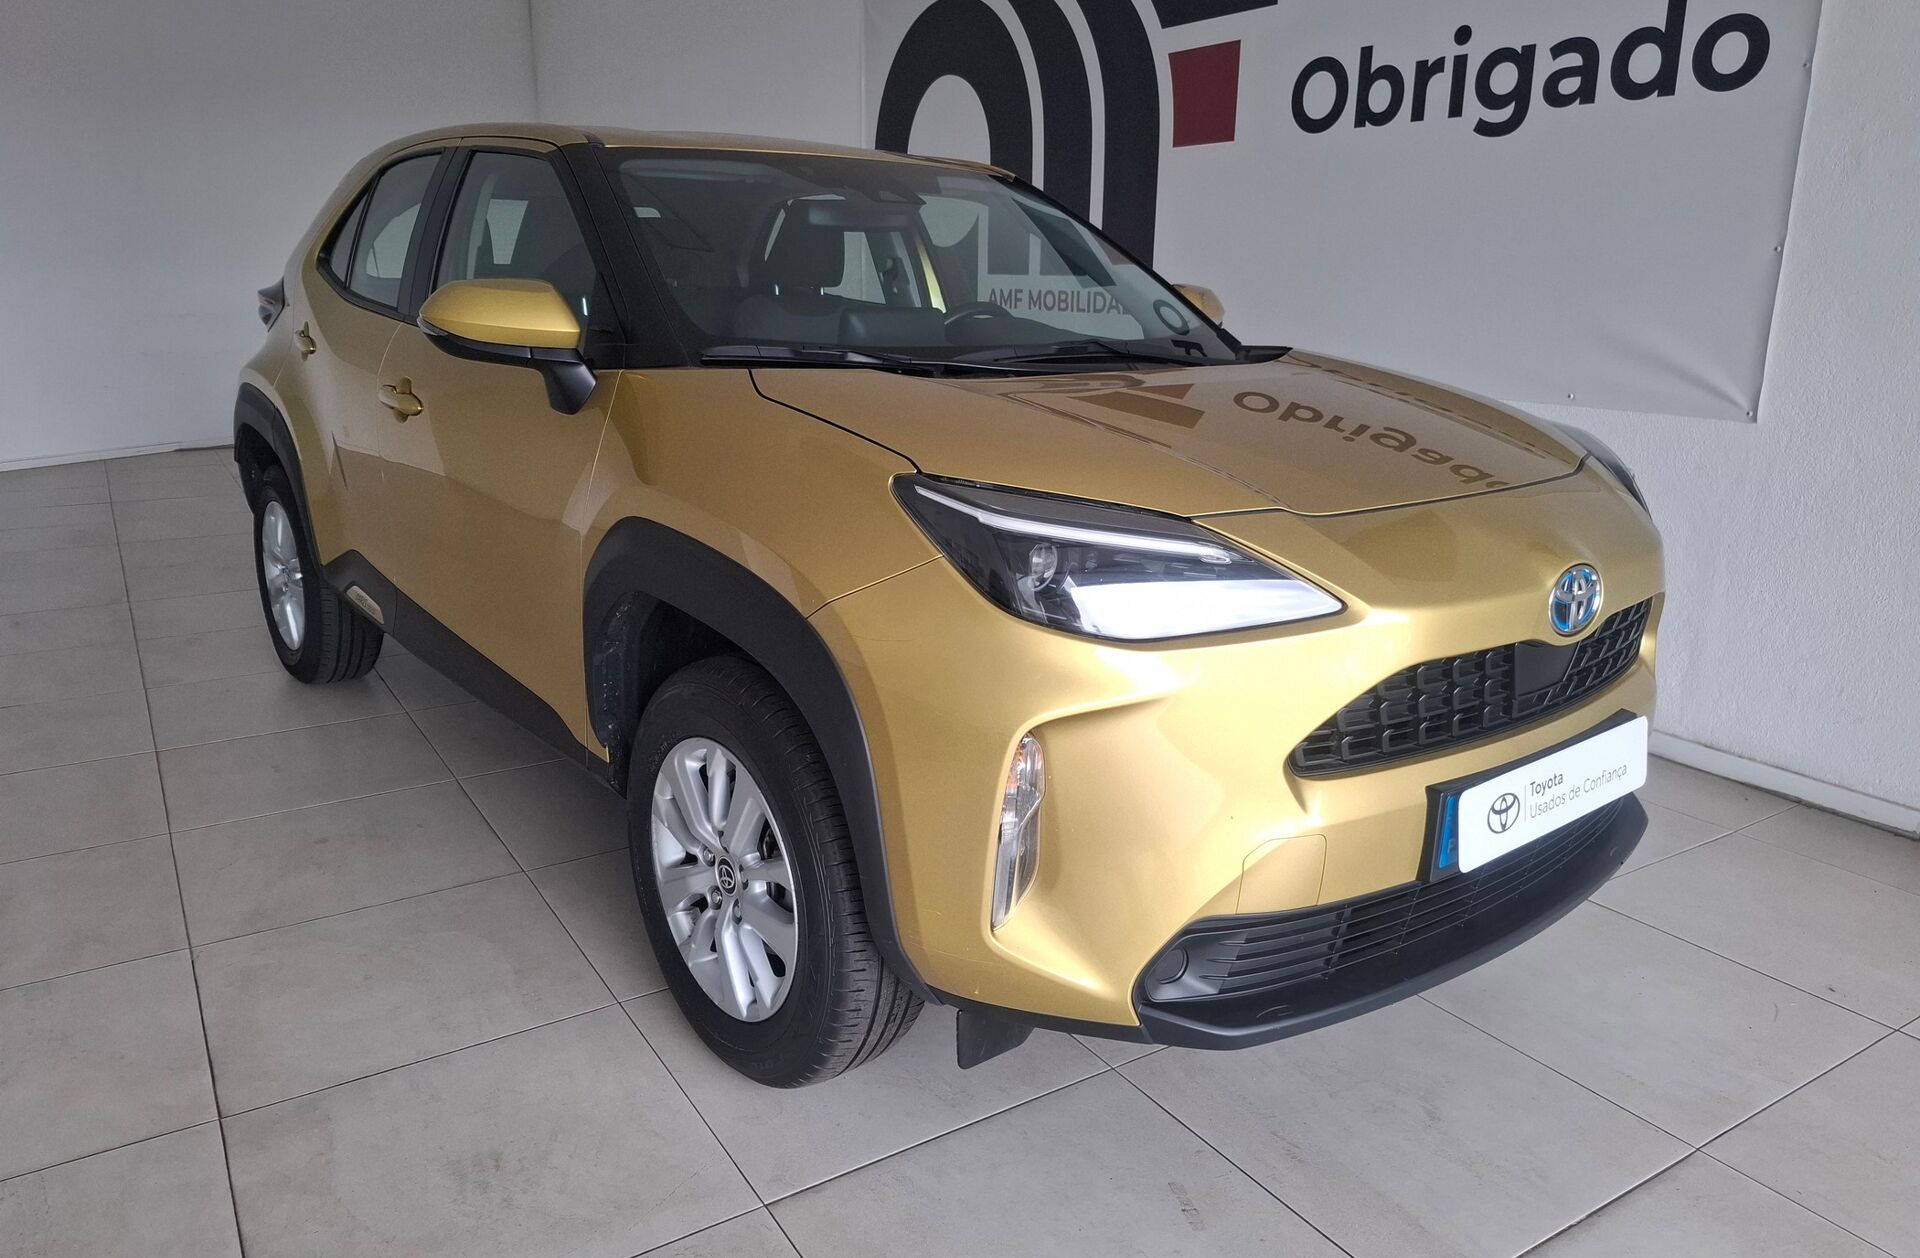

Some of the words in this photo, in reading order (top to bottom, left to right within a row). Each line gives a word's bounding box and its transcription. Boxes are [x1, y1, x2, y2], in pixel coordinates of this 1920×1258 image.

[1291, 0, 1770, 138] Obrigado
[989, 287, 1024, 310] AMF
[1028, 289, 1127, 315] MOBILIDA
[1529, 773, 1564, 797] Toyota
[1530, 793, 1566, 819] Usados
[1568, 784, 1581, 801] de
[1583, 764, 1627, 793] Confiança
